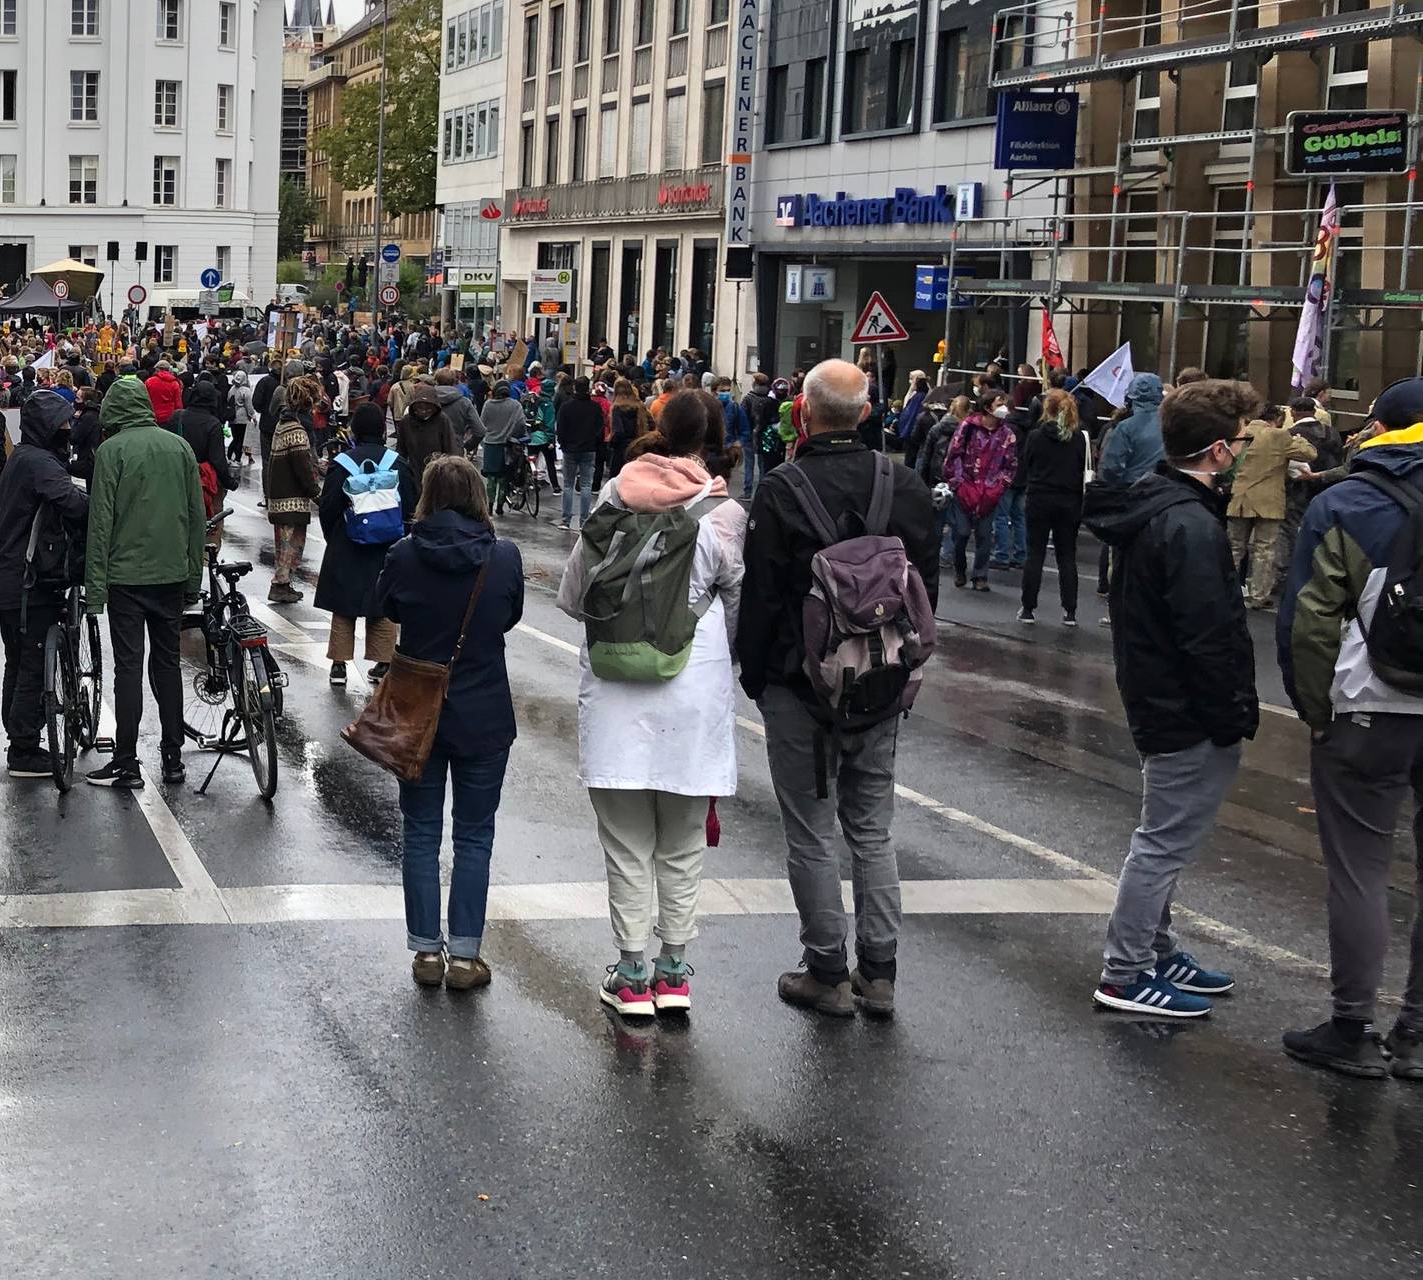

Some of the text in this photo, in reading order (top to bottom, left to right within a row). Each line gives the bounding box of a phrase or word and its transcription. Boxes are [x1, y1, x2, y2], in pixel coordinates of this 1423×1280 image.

[1012, 100, 1054, 112] Allianz
[731, 0, 757, 242] AACHENER BANK
[1303, 128, 1398, 152] Göbbels
[1009, 141, 1061, 150] Filialdirektion
[1009, 153, 1038, 161] Aachen
[802, 184, 956, 227] Aachener Bank
[464, 272, 493, 281] DKV
[57, 285, 66, 294] 10
[385, 291, 395, 300] 10
